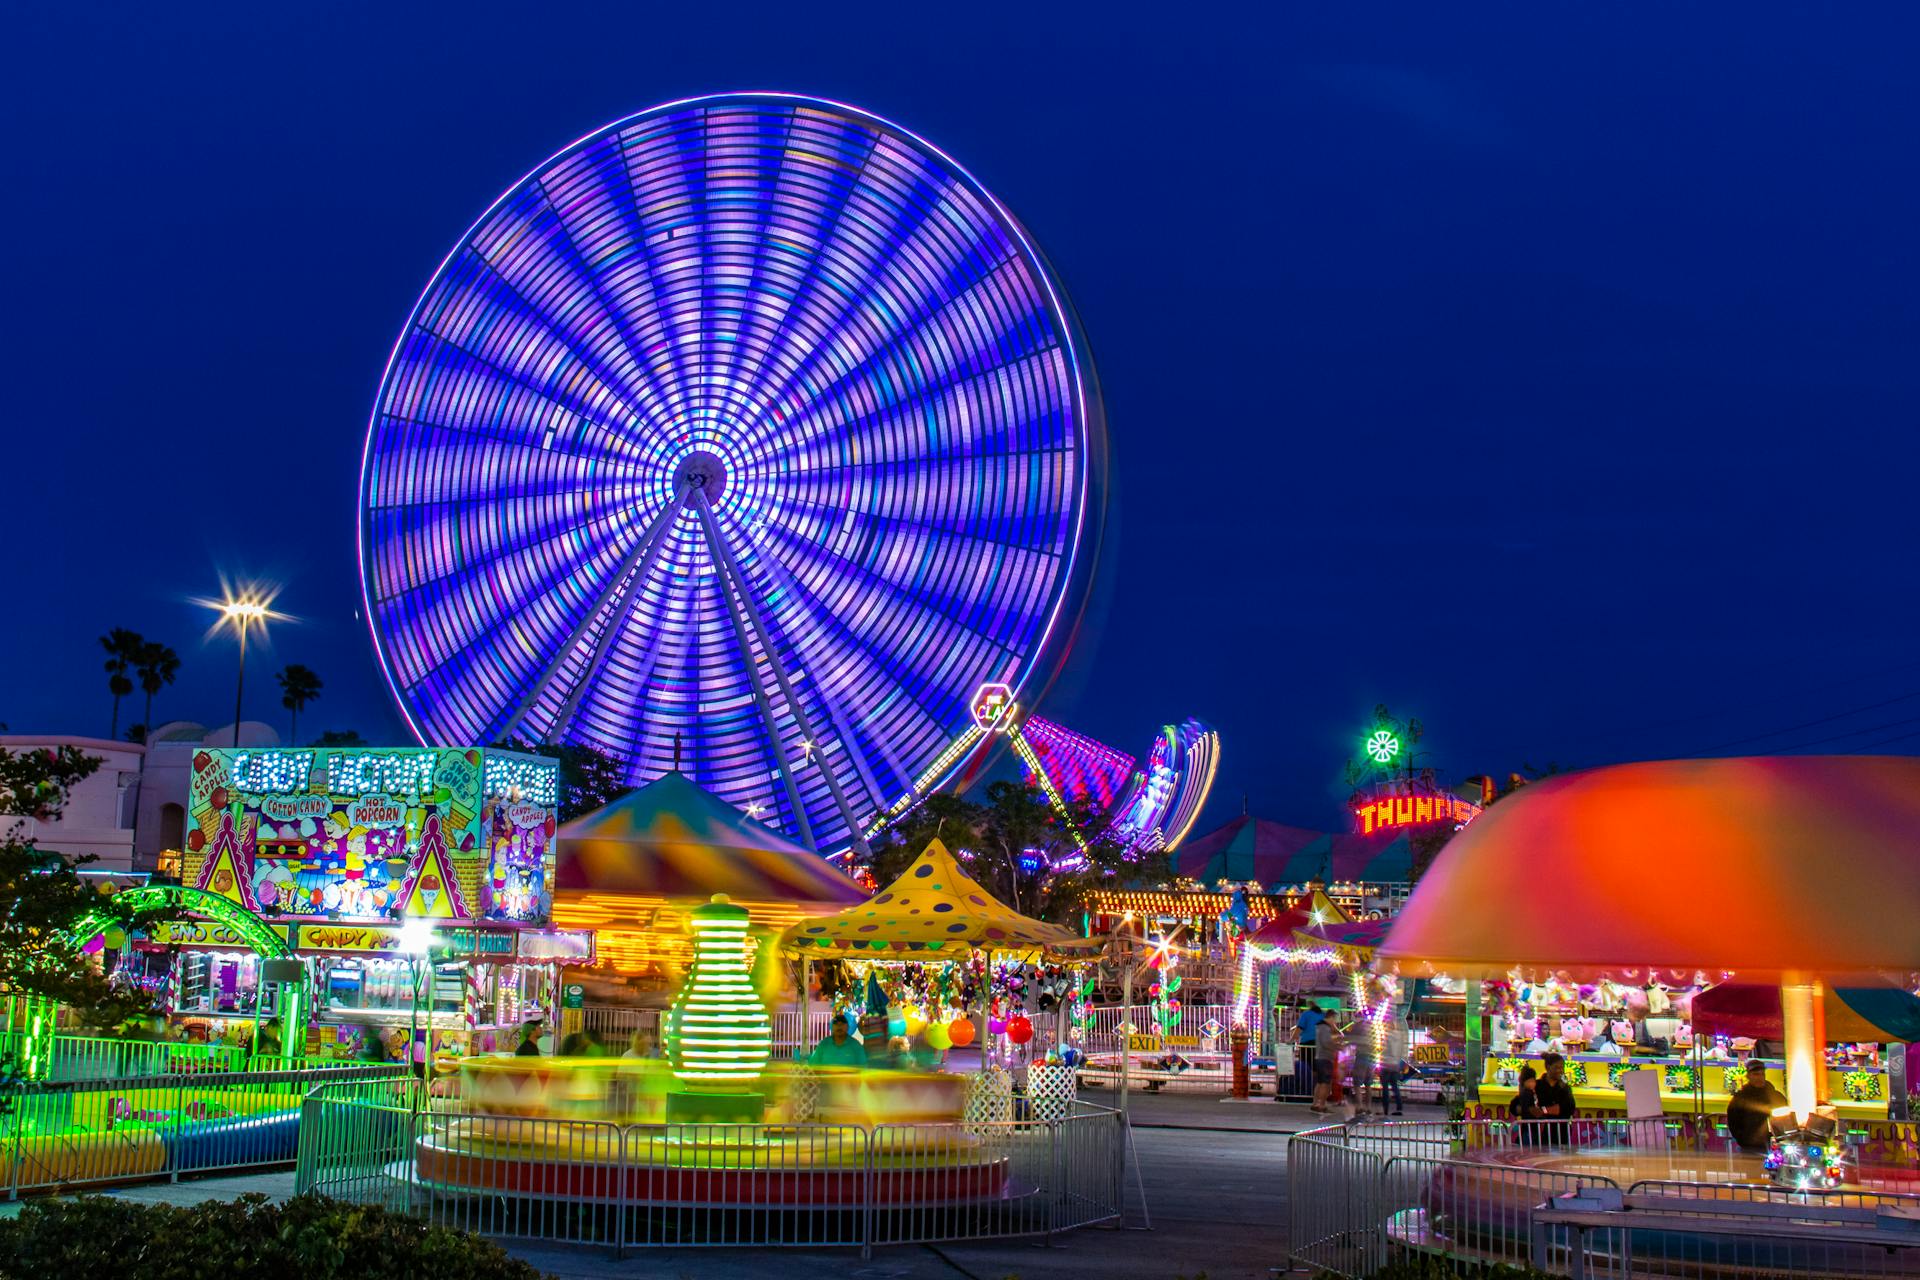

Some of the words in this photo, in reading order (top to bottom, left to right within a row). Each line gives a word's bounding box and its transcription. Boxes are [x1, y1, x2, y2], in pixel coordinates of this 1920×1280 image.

[194, 759, 221, 790] CANDY
[232, 750, 315, 795] CANDY
[328, 752, 437, 796] FACTORY
[451, 760, 471, 784] SNO
[485, 755, 557, 806] POPCORN
[200, 769, 229, 800] APPLES
[438, 770, 469, 800] CONES
[268, 800, 297, 817] COTTON
[300, 801, 327, 814] CANDY
[365, 798, 385, 807] HOT
[511, 806, 531, 816] CANDY
[355, 807, 399, 822] POPCORN
[521, 811, 544, 823] APPLES
[169, 925, 207, 942] SNO
[307, 927, 367, 948] CANDY
[450, 932, 477, 952] OLD
[479, 933, 512, 952] DRINKS
[1130, 1037, 1155, 1050] EXIT
[1417, 1046, 1448, 1060] ENTER
